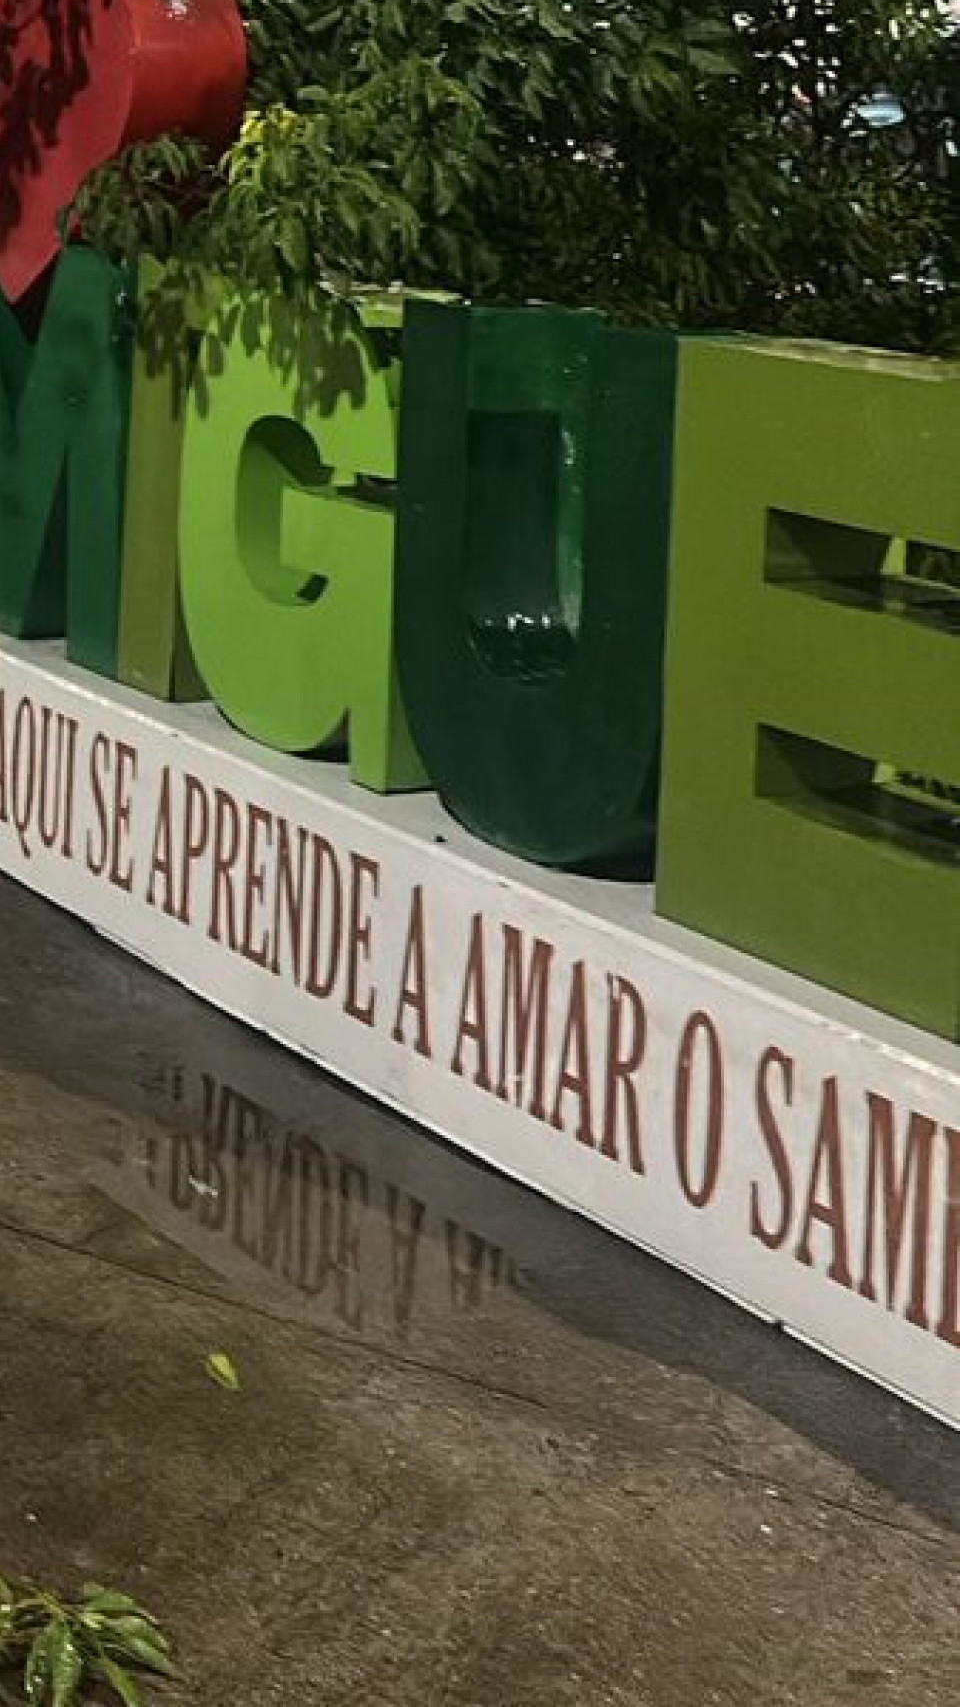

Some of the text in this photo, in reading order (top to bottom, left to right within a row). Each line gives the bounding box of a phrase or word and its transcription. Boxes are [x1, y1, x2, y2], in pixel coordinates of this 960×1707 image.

[87, 731, 138, 891] SE
[147, 766, 380, 1027] APRENDE
[392, 884, 433, 1059] A
[450, 911, 648, 1175] AMAR
[673, 1009, 726, 1209] O
